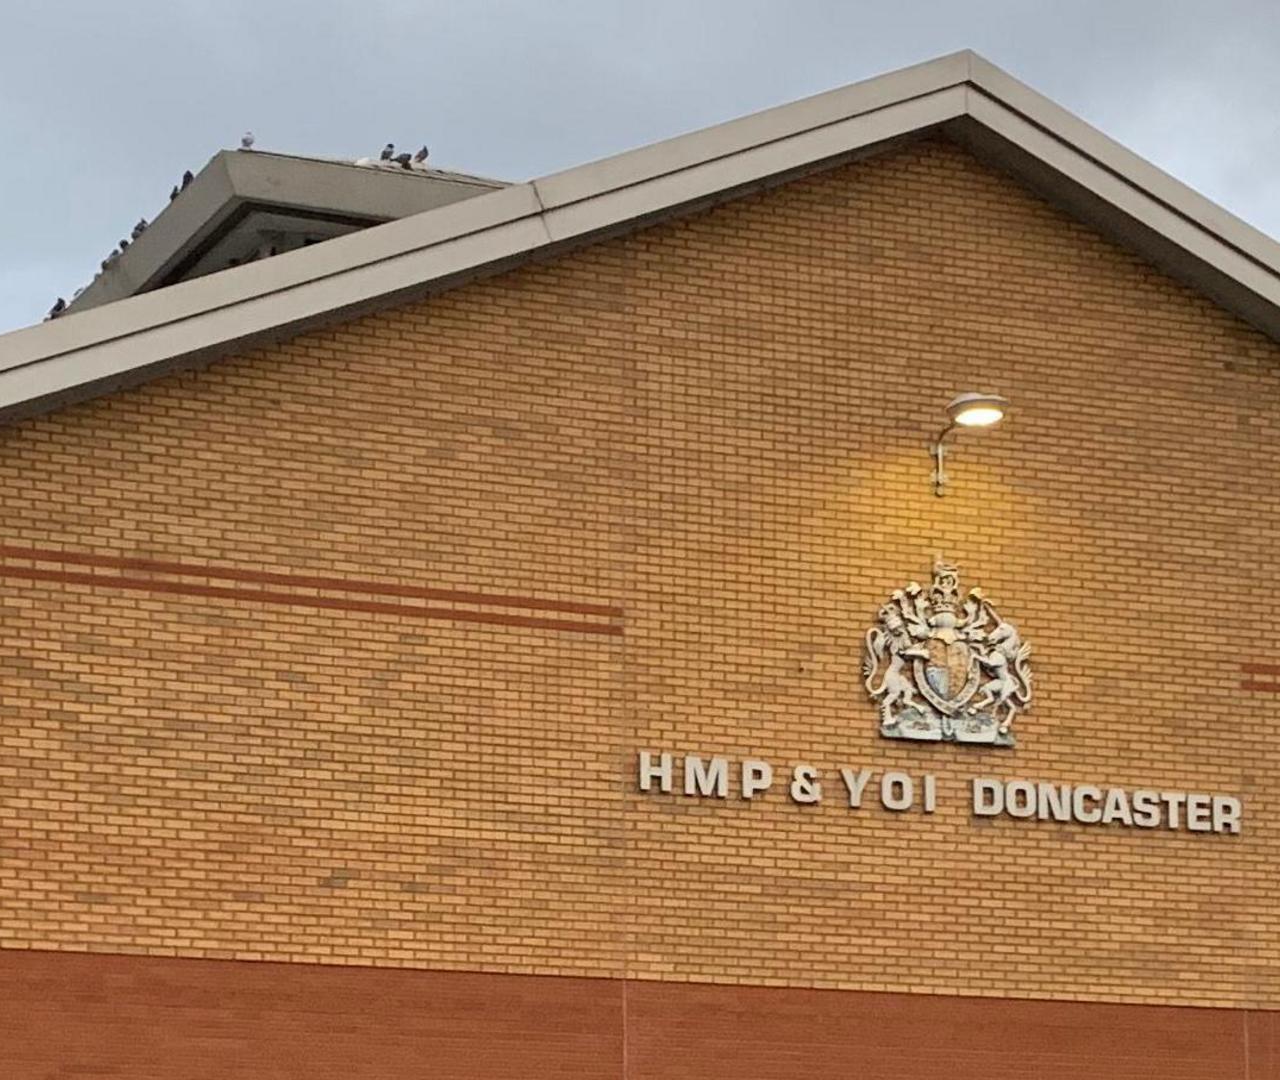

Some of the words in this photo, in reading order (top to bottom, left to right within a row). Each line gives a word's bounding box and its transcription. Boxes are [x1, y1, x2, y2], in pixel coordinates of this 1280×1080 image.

[638, 751, 773, 799] HMP
[790, 765, 821, 803] &
[840, 767, 936, 813] YOI
[972, 778, 1242, 834] DONCASTER
